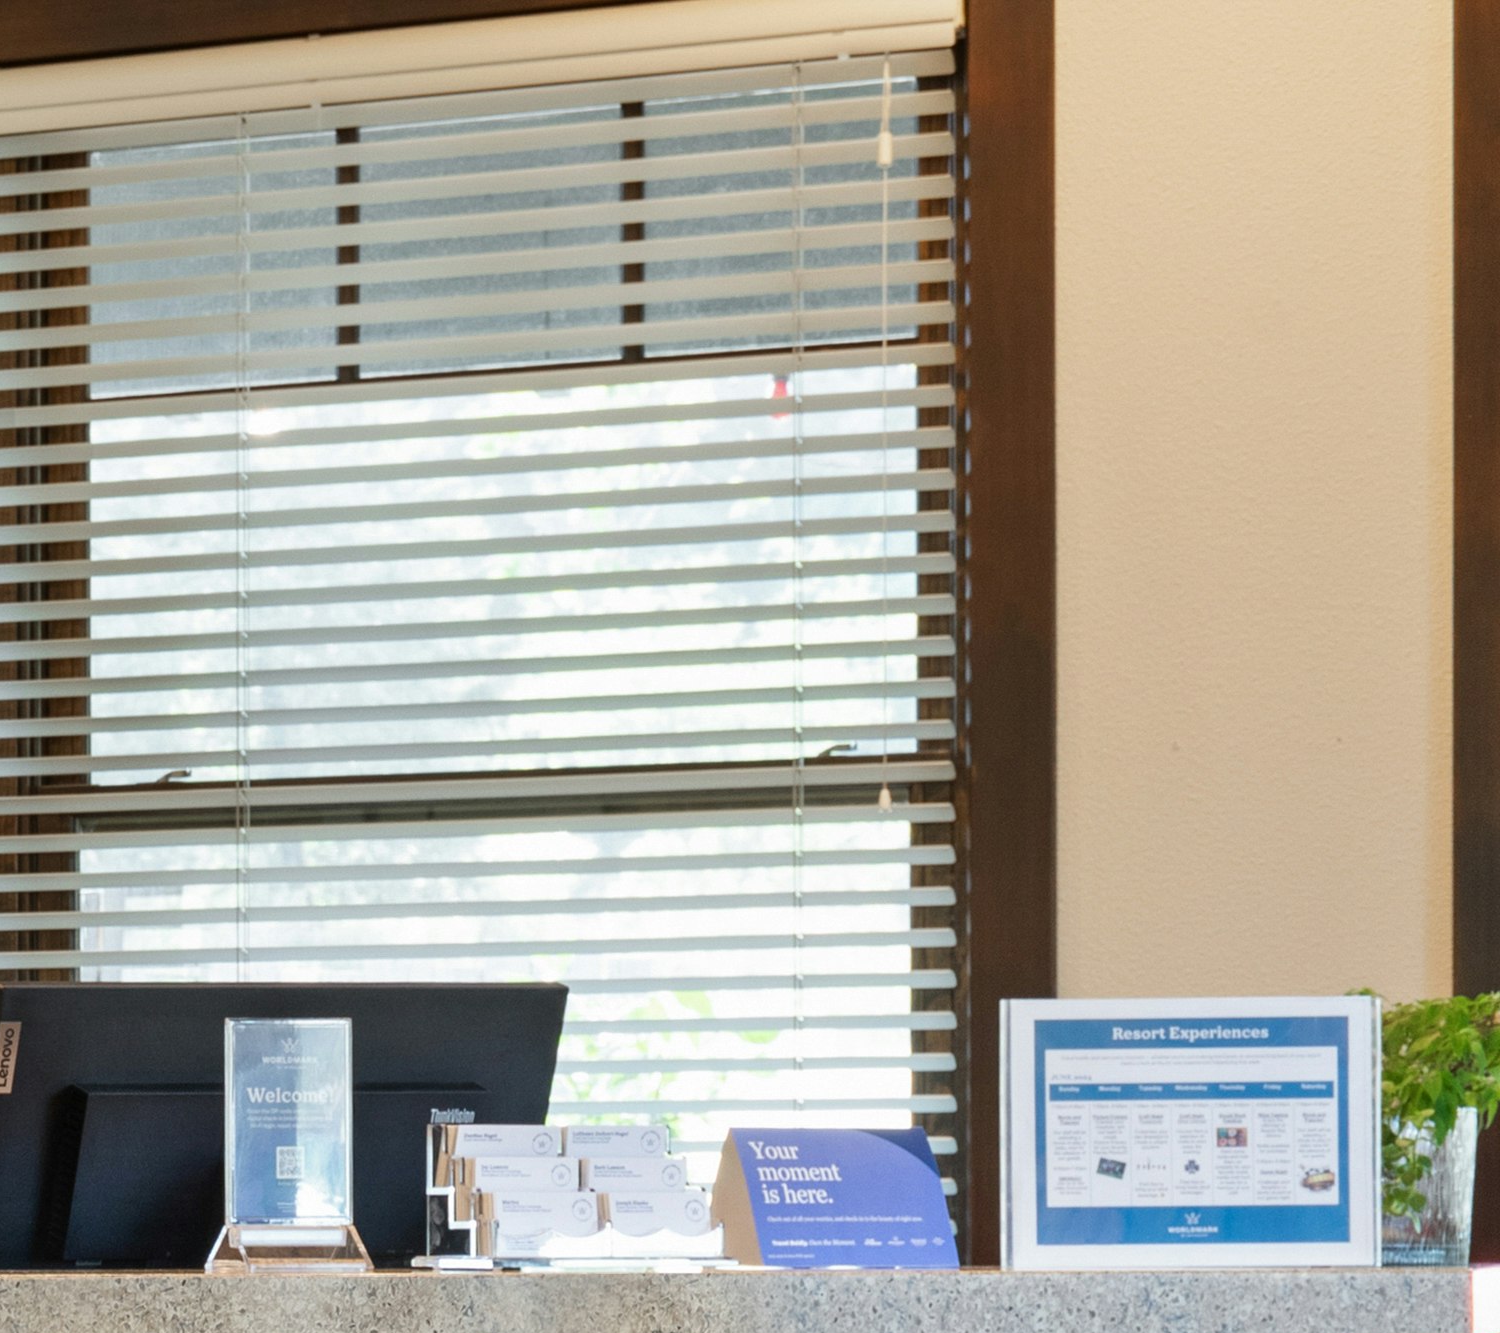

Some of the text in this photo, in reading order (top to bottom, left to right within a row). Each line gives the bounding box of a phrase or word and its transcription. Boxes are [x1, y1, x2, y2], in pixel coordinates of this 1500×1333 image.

[1112, 1026, 1270, 1043] Resort Experiences
[747, 1140, 799, 1160] Your
[756, 1163, 842, 1182] moment
[762, 1183, 834, 1204] is here.
